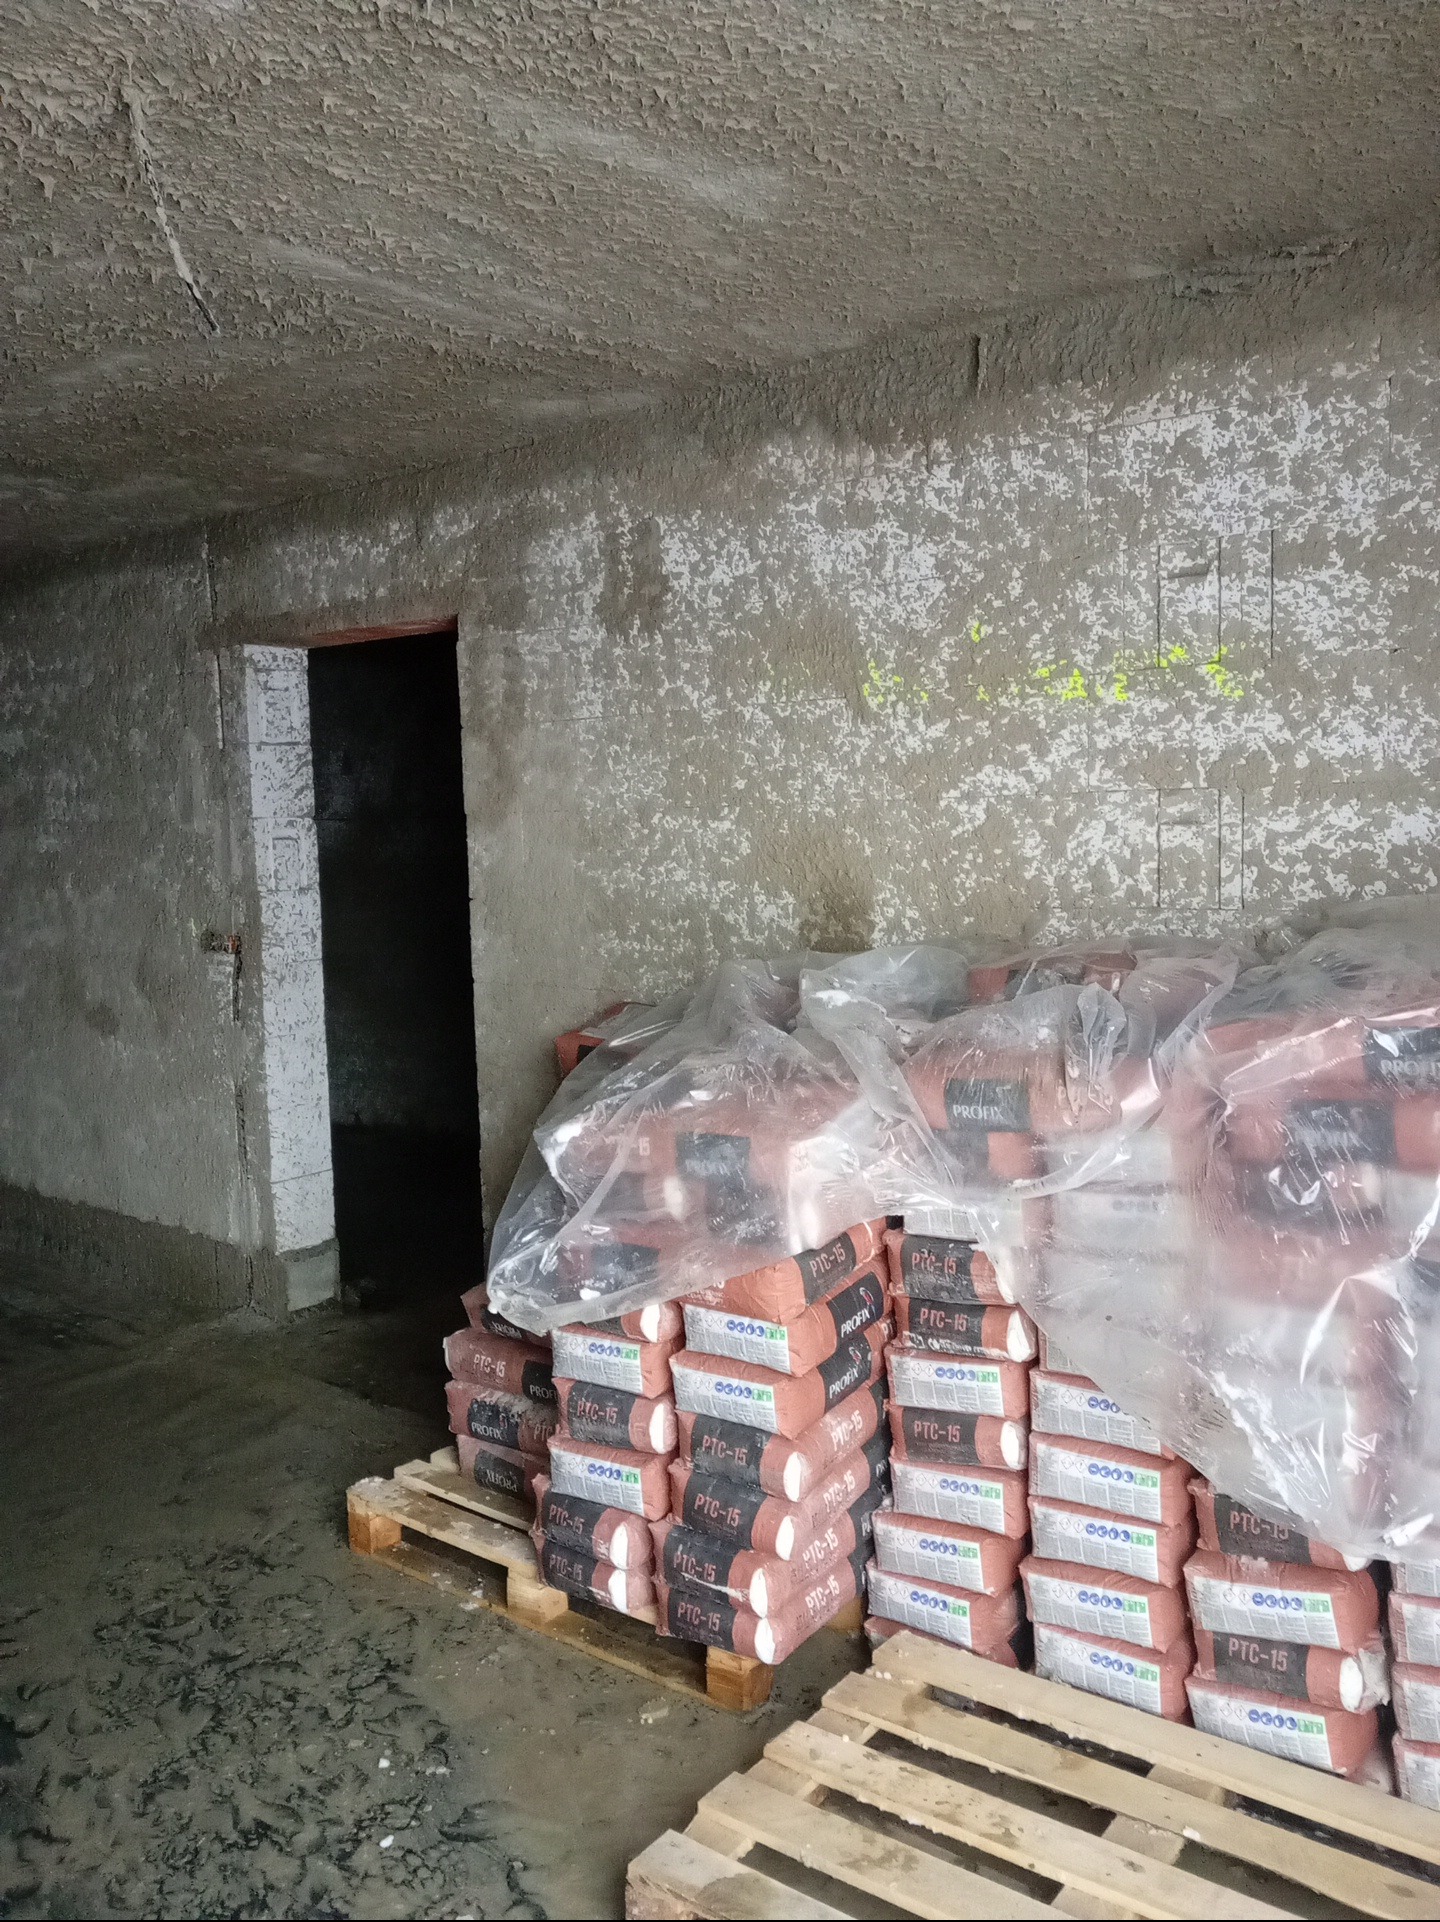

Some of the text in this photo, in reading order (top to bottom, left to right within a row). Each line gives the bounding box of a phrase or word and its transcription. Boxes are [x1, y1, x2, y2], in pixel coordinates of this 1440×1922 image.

[953, 1103, 1004, 1120] PROFIX
[809, 1242, 846, 1278] PTC-15
[911, 1252, 957, 1275] PTC-15
[841, 1305, 871, 1338] PROFIX
[919, 1307, 968, 1332] PTC-15
[474, 1353, 506, 1378] PTC-15
[530, 1384, 557, 1400] PROFI
[829, 1364, 860, 1398] PROFIX
[577, 1400, 617, 1424] PTC-15
[471, 1421, 502, 1440] PROFIX
[831, 1409, 863, 1451] PTC-15
[914, 1420, 960, 1442] PTC-15
[702, 1435, 748, 1465] PTC-15
[824, 1469, 856, 1512] PTC-15
[549, 1505, 585, 1535] PTC-15
[695, 1493, 741, 1527] PTC-15
[803, 1528, 839, 1570] PTC-15
[549, 1554, 583, 1581] PTC-15
[673, 1551, 716, 1583] PTC-15
[805, 1574, 840, 1616] PTC-15
[678, 1602, 721, 1631] PTC-15
[1229, 1638, 1288, 1672] PTC-15
